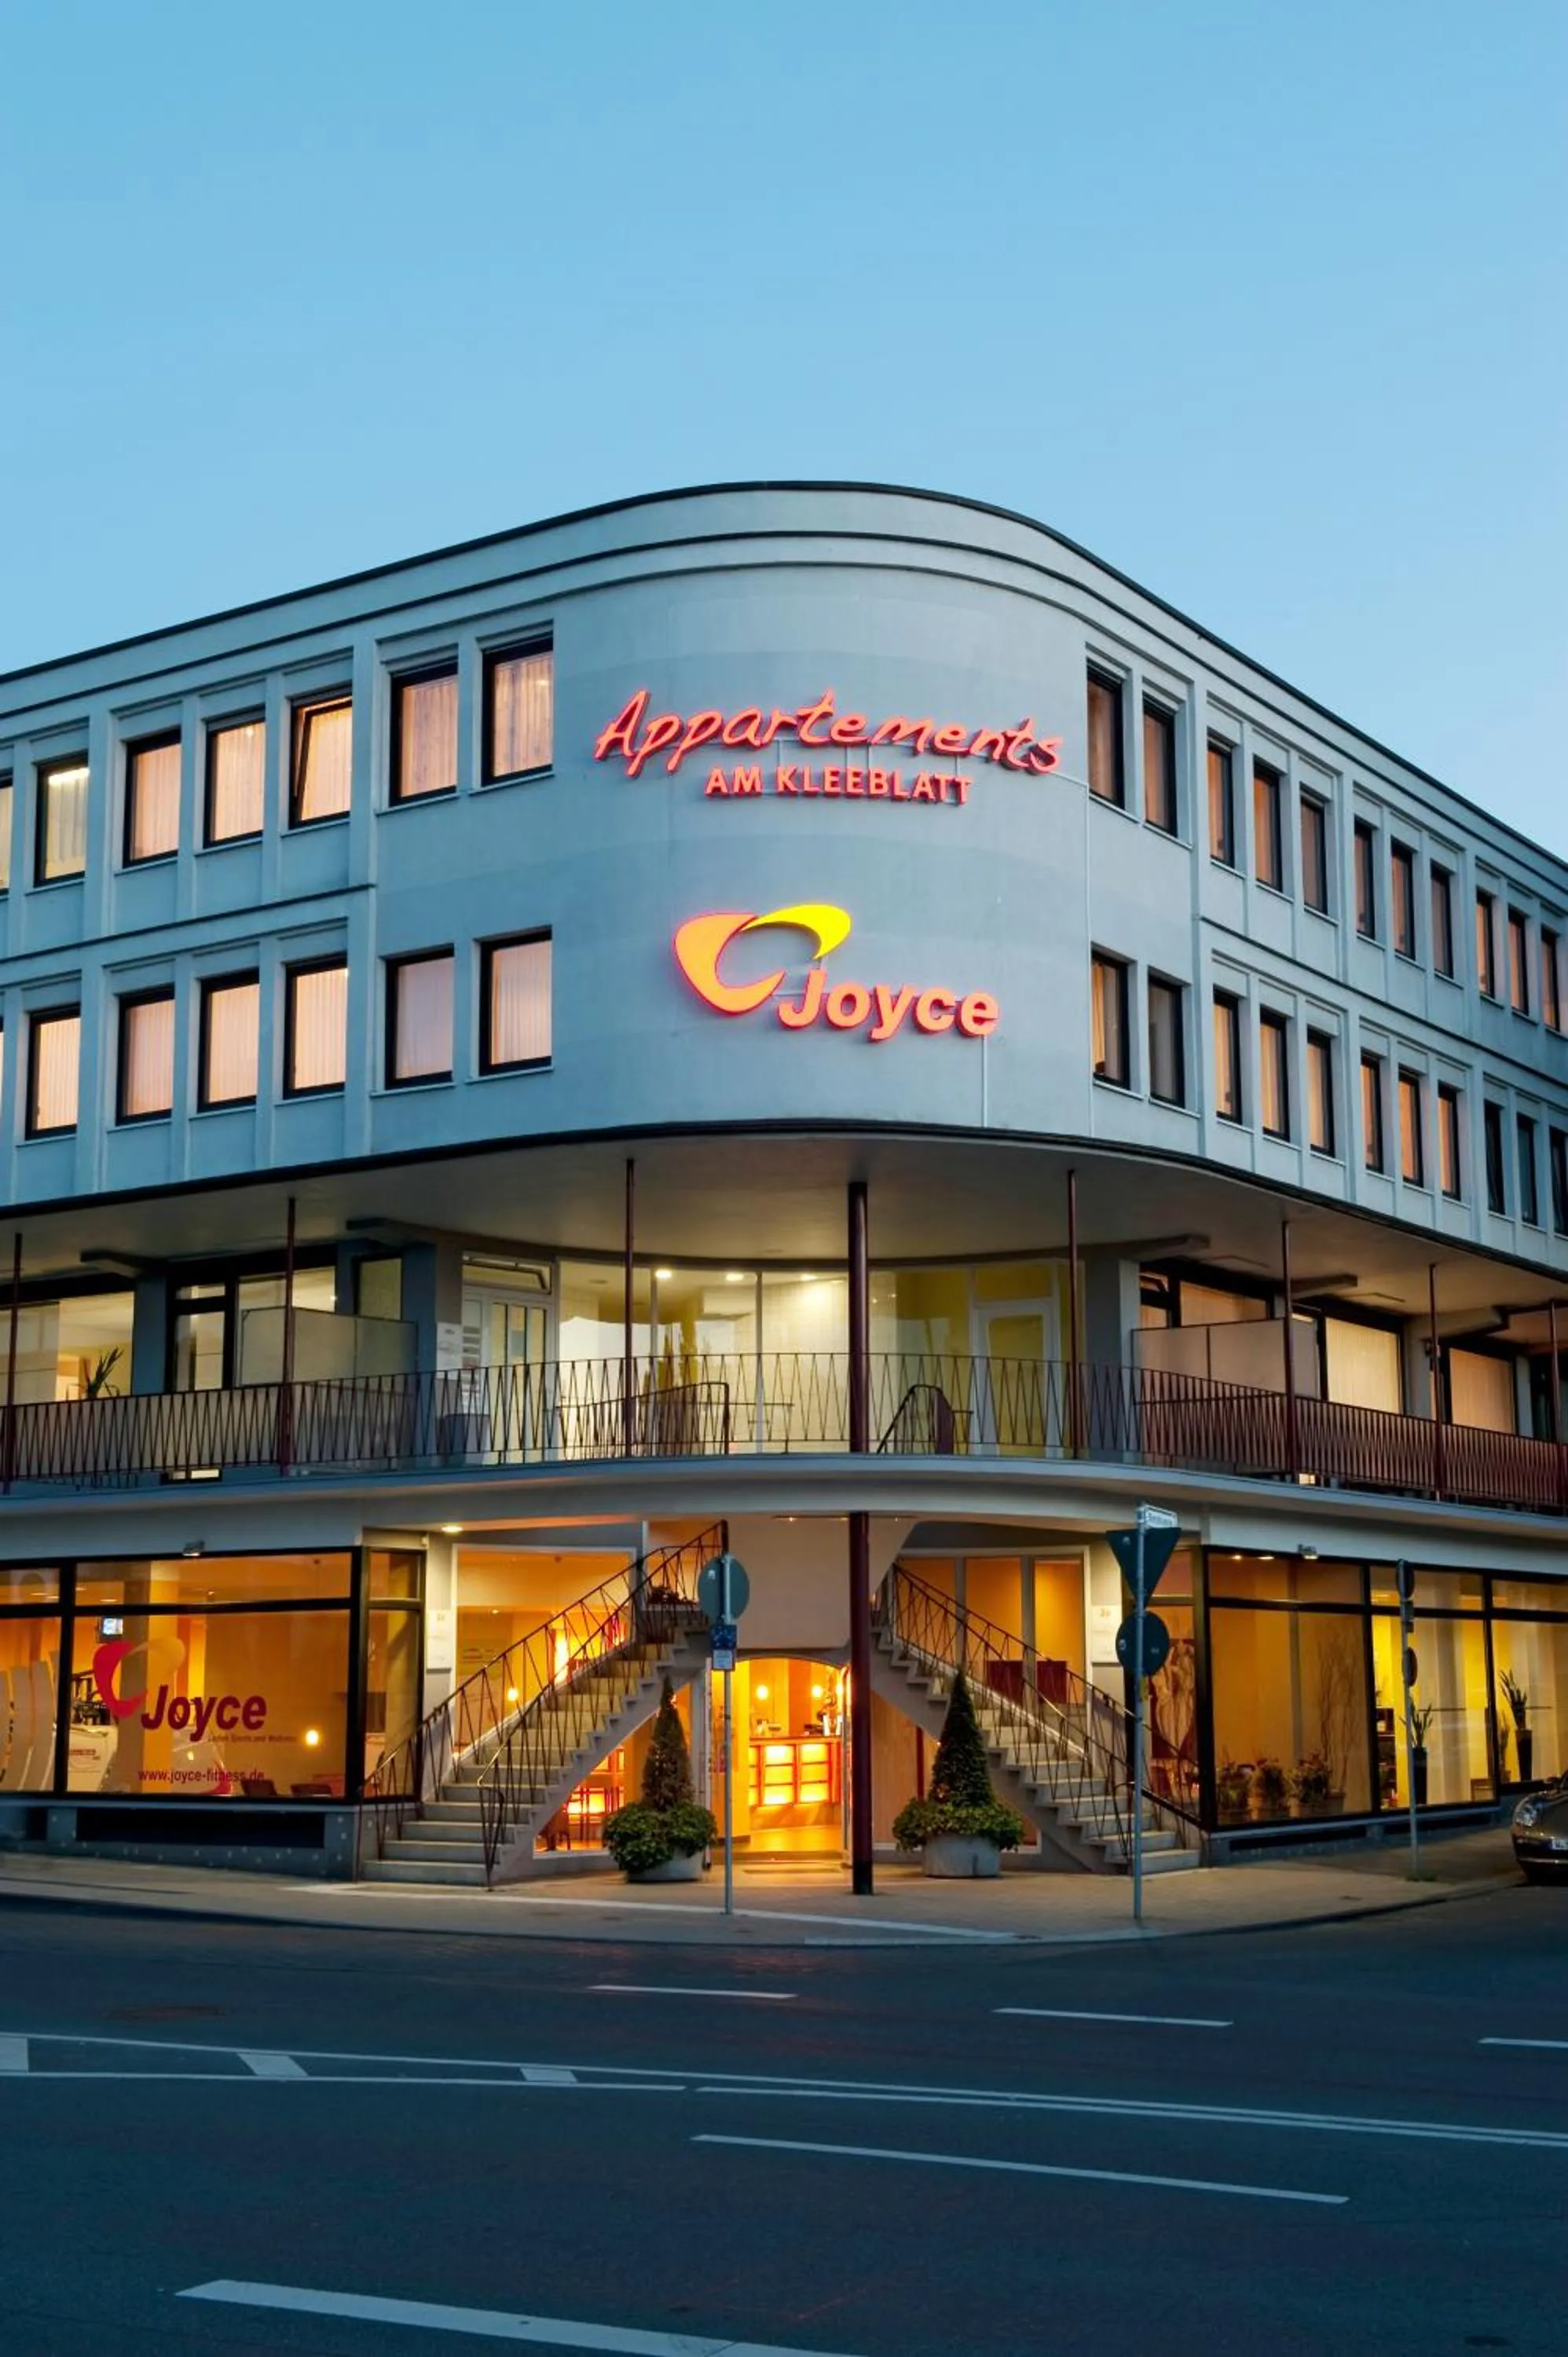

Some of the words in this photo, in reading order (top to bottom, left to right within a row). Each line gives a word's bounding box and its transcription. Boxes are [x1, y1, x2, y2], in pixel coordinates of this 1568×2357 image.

[595, 689, 1064, 777] Appartements
[704, 766, 763, 797] AM
[775, 766, 973, 806] KLEEBLATT
[777, 968, 1000, 1043] Joyce
[141, 1684, 268, 1743] Joyce
